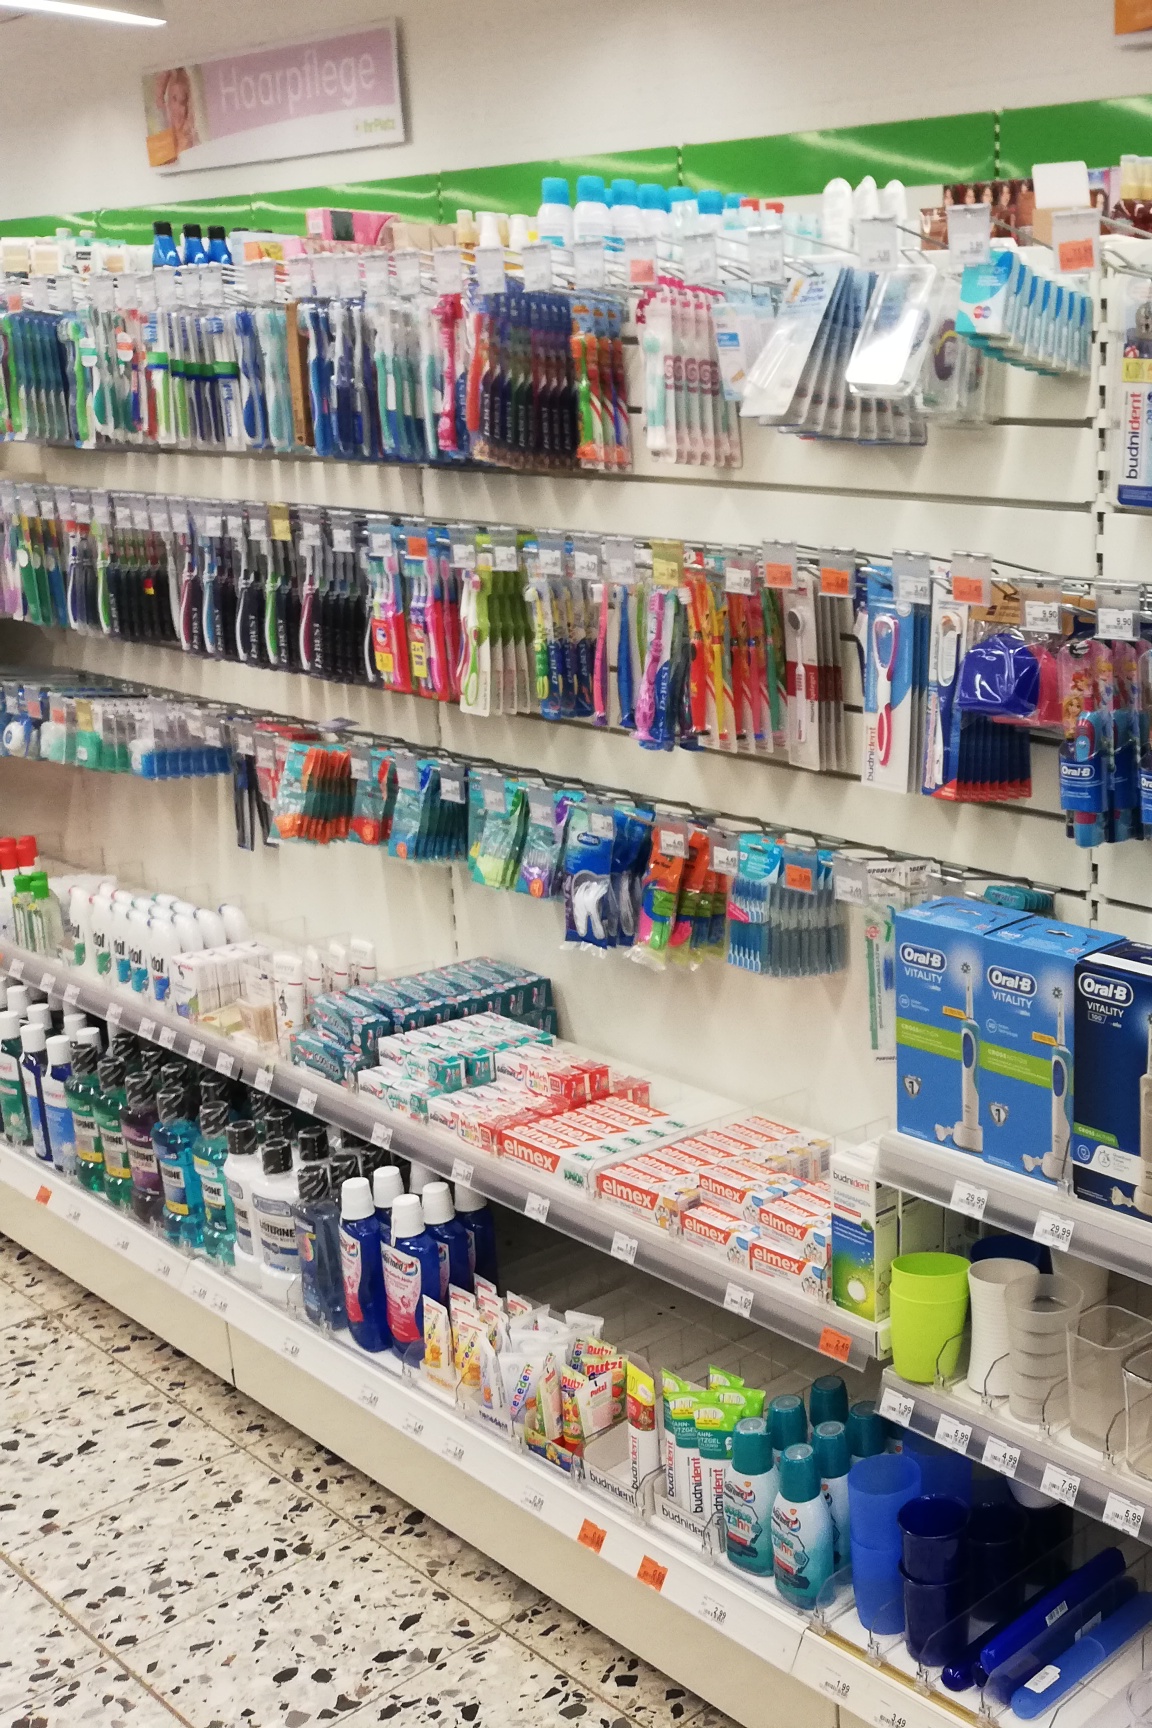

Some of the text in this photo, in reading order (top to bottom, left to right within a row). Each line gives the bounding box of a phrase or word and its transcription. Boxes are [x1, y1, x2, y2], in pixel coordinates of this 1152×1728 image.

[220, 50, 375, 114] Haarpflege
[1125, 392, 1142, 480] budnident
[867, 727, 876, 782] budnident
[1062, 766, 1094, 777] Oral-B
[904, 948, 942, 968] Oral-B
[904, 966, 943, 984] VITALITY
[990, 970, 1032, 991] Oral-B
[991, 990, 1033, 1009] VITALITY
[1083, 978, 1128, 1000] Oral-B
[1086, 1001, 1124, 1019] VITALITY
[539, 1118, 591, 1142] elmex
[563, 1111, 616, 1134] elmex
[513, 1125, 569, 1150] elmex
[503, 1140, 554, 1172] elmex
[700, 1176, 742, 1204] elmex
[832, 1170, 870, 1192] budnident
[601, 1178, 653, 1210] elmex
[965, 1192, 986, 1205] 29.99
[684, 1217, 726, 1245] elmex
[761, 1210, 803, 1241] elmex
[1050, 1223, 1072, 1238] 29.99
[754, 1247, 800, 1275] elmex
[586, 1356, 623, 1375] putzi
[953, 1429, 969, 1442] 5.99
[667, 1440, 675, 1498] budnident
[1001, 1452, 1018, 1465] 4.99
[589, 1470, 635, 1505] budnident
[691, 1457, 704, 1514] budnident
[1061, 1479, 1077, 1494] 7.99
[661, 1504, 711, 1540] budnident
[1124, 1509, 1142, 1524] 5.99
[836, 1679, 850, 1694] 1.99
[890, 1713, 907, 1728] 3.49
